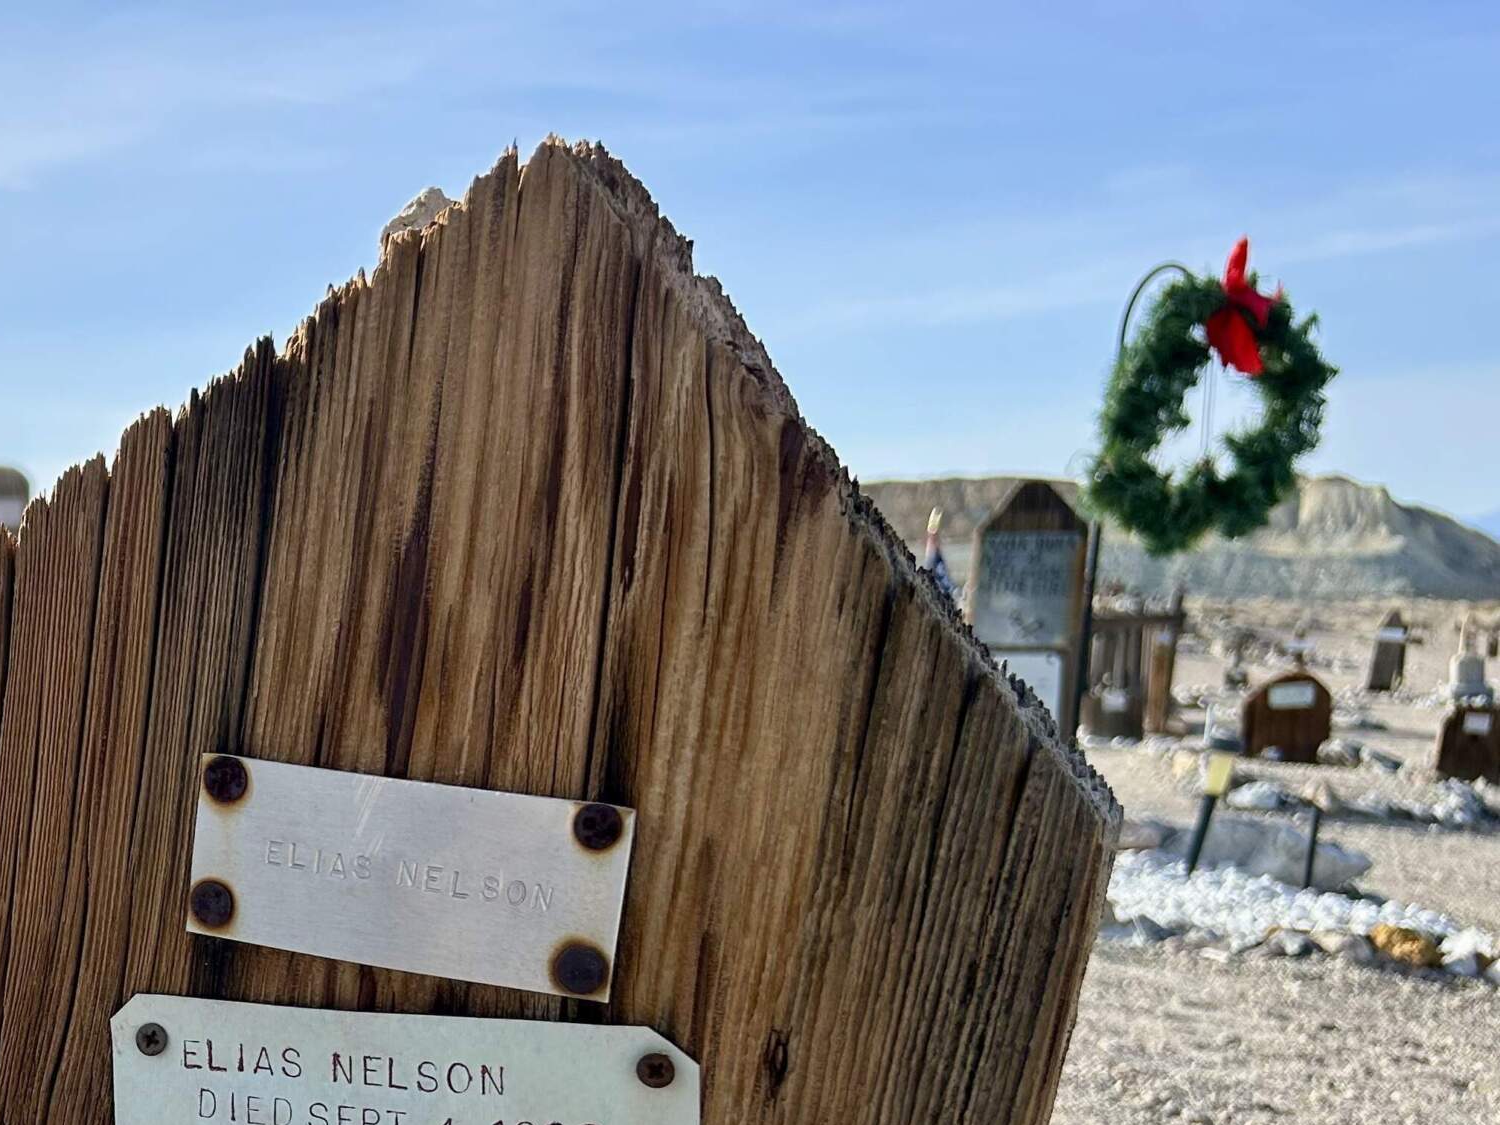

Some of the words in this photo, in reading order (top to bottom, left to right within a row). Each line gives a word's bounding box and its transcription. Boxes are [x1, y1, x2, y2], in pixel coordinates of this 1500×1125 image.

[265, 840, 372, 880] ELIAS
[396, 860, 554, 912] NELSON
[183, 1038, 302, 1078] ELIAS
[331, 1052, 504, 1096] NELSON
